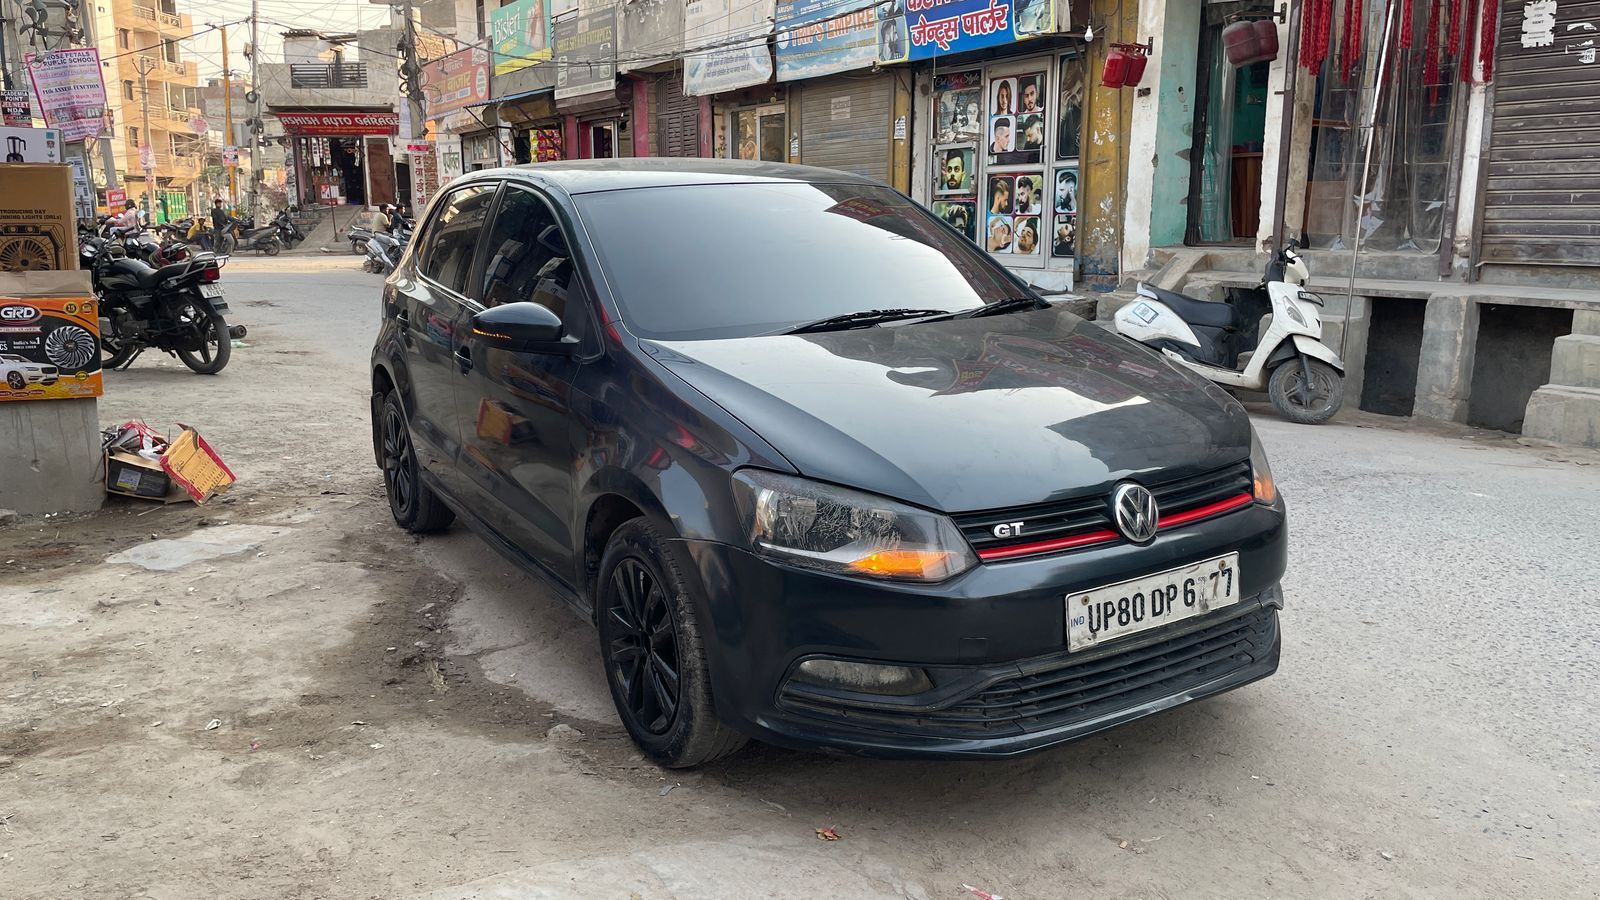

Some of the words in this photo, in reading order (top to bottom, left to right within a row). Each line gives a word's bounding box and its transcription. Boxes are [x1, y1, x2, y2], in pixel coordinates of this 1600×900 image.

[789, 20, 824, 46] TRIPS
[826, 8, 875, 39] EMPIRE
[281, 116, 320, 125] ASHISH
[322, 116, 352, 127] AUTO
[355, 117, 400, 126] GARAGE
[1, 306, 35, 319] GRD
[993, 522, 1024, 539] GT
[1070, 615, 1085, 628] IND
[1088, 592, 1146, 634] UP80
[1151, 583, 1178, 617] DP
[1183, 567, 1233, 607] 677
